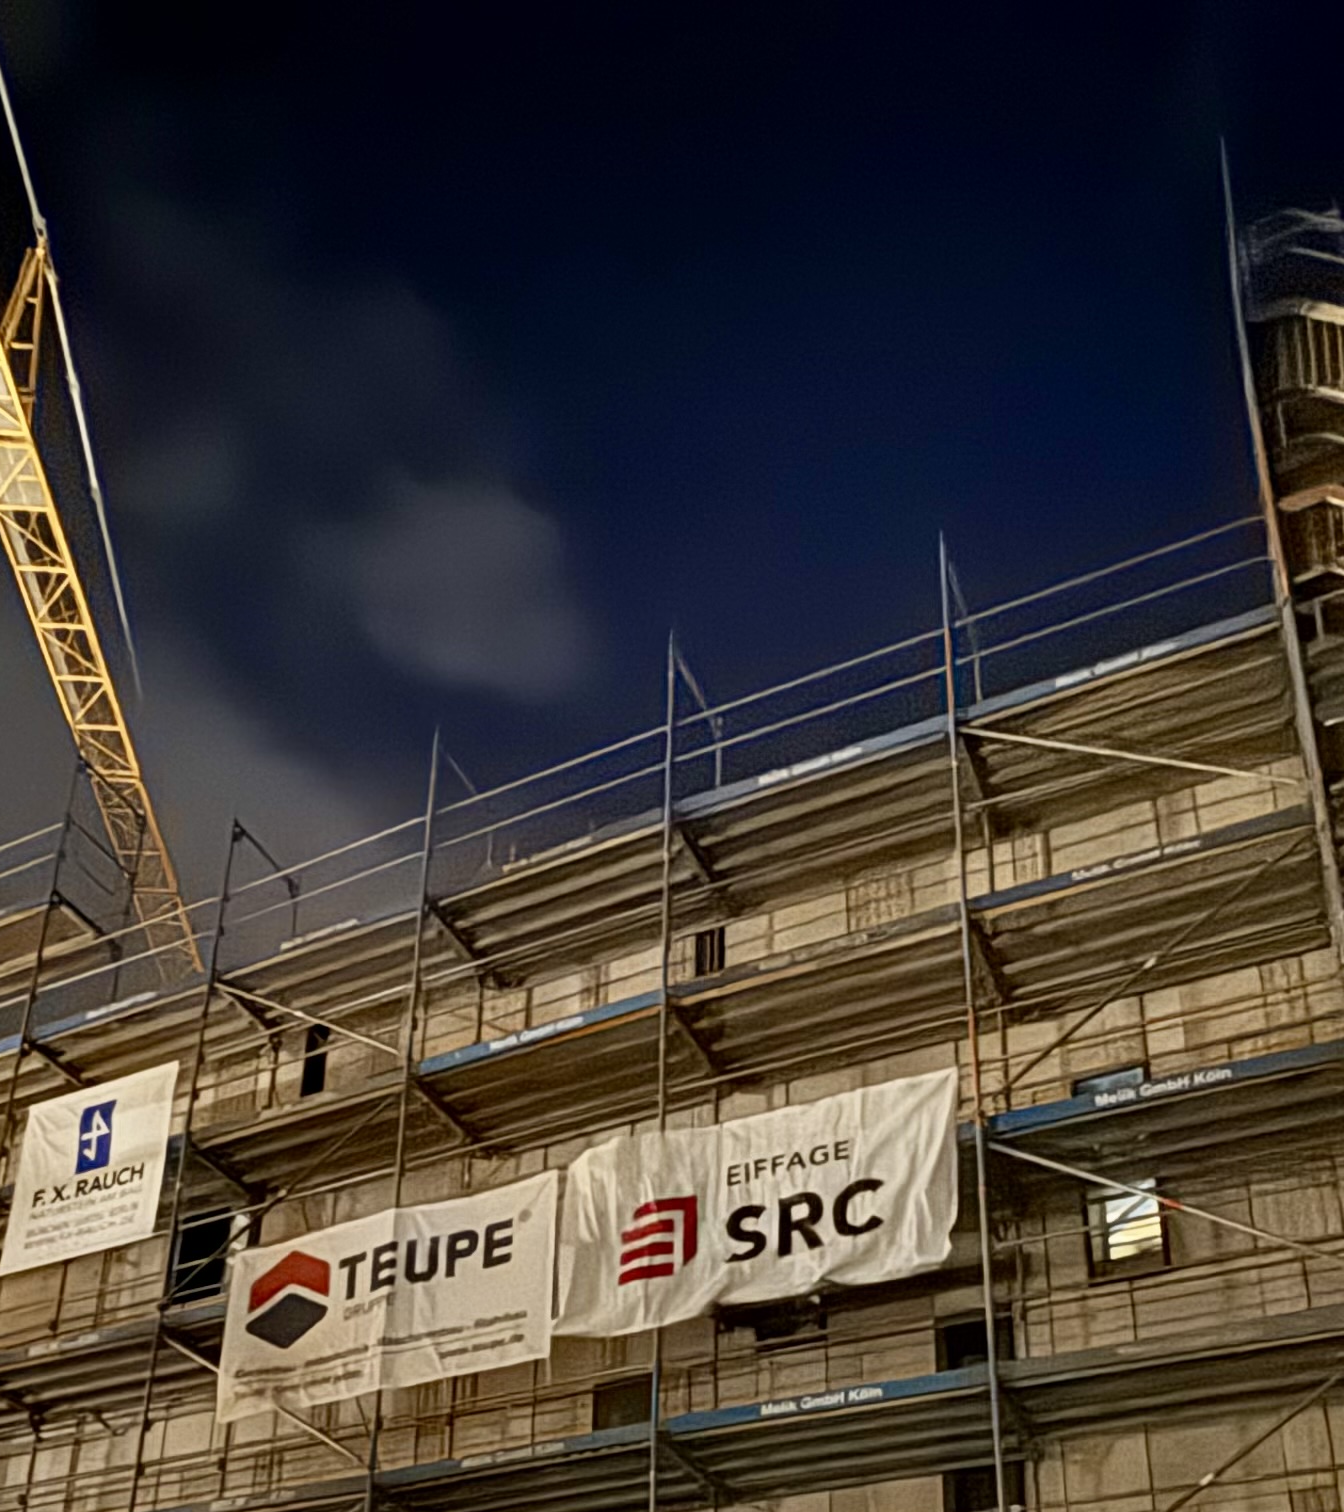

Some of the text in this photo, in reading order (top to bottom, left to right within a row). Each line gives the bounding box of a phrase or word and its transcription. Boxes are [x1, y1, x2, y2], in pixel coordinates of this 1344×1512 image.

[1139, 1078, 1189, 1098] GmbH
[1193, 1067, 1232, 1086] Köln
[31, 1188, 46, 1208] F.
[50, 1183, 70, 1204] X.
[75, 1162, 145, 1198] RAUCH
[726, 1139, 850, 1187] EIFFAGE
[725, 1177, 884, 1264] SRC
[338, 1217, 514, 1300] TEUPE
[800, 1391, 845, 1410] GmbH
[848, 1384, 883, 1402] Köln
